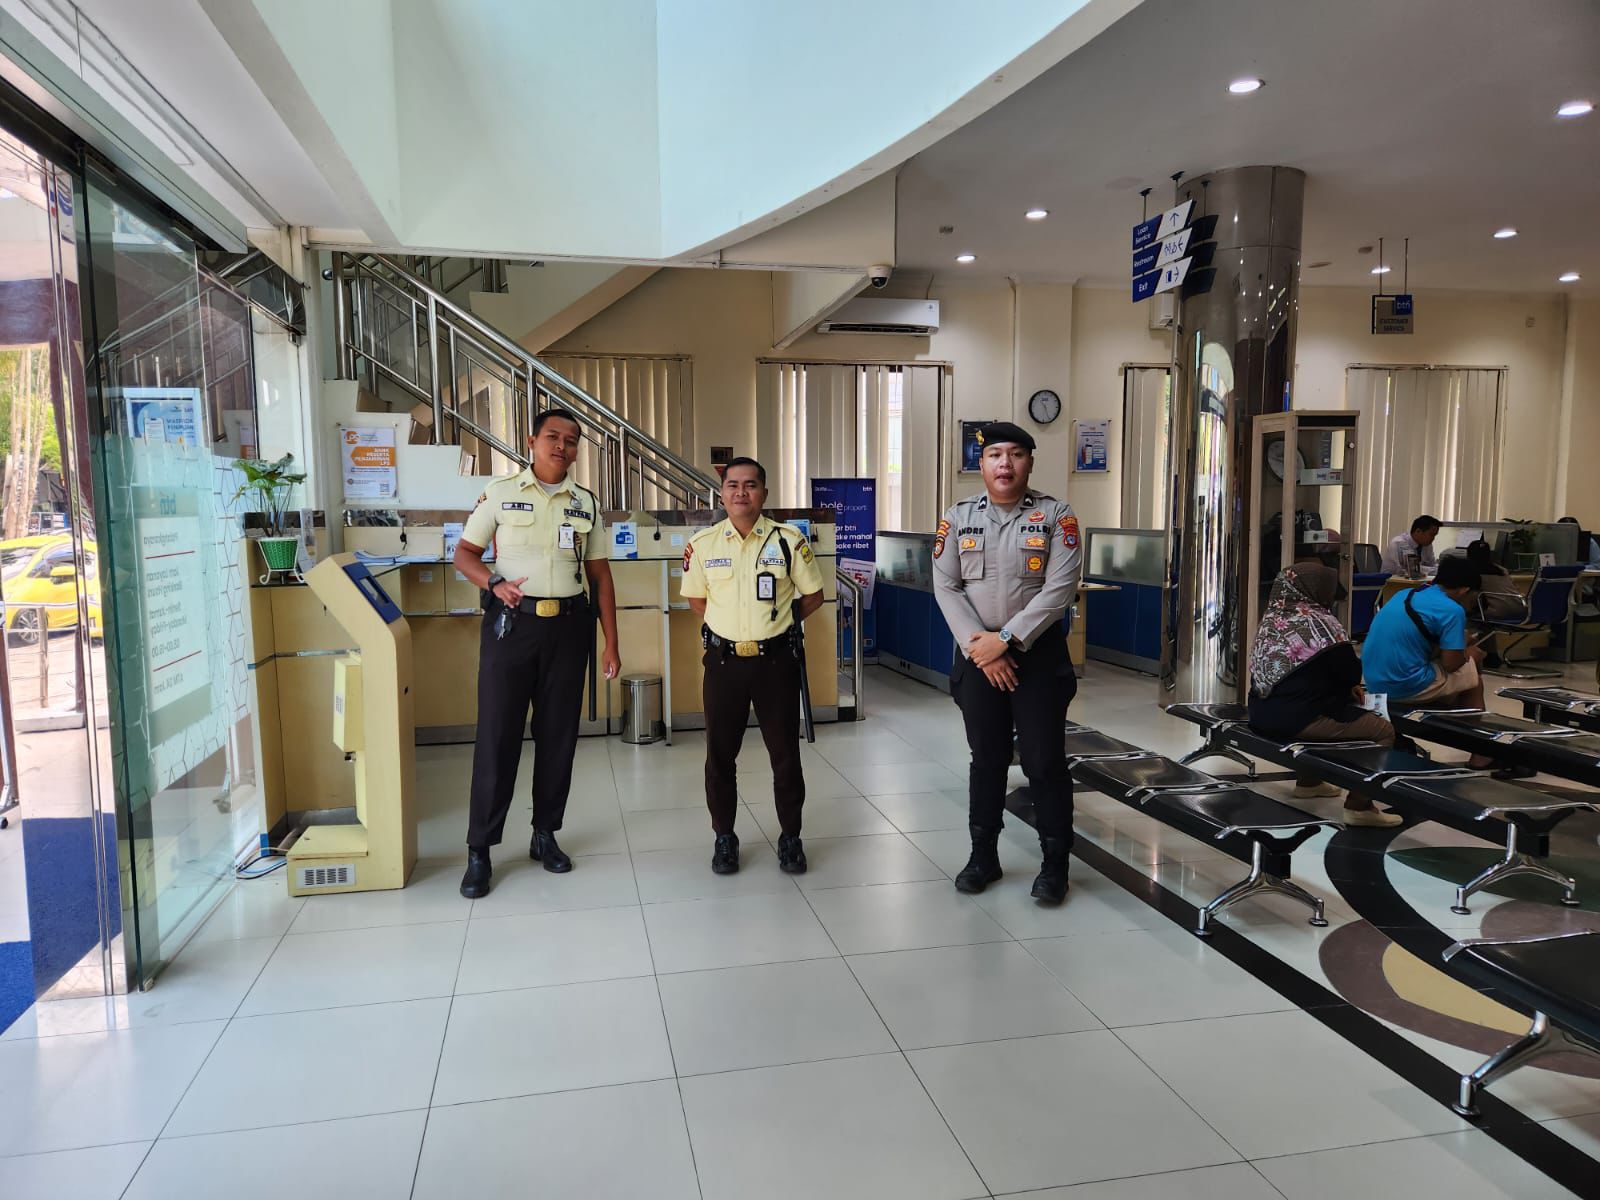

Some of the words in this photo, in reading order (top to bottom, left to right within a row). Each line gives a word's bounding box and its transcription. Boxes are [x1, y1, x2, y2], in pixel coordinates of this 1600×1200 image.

[1135, 233, 1151, 244] Service
[1134, 255, 1154, 267] Restroom
[1138, 281, 1149, 292] Exit
[958, 527, 984, 537] ANDRE
